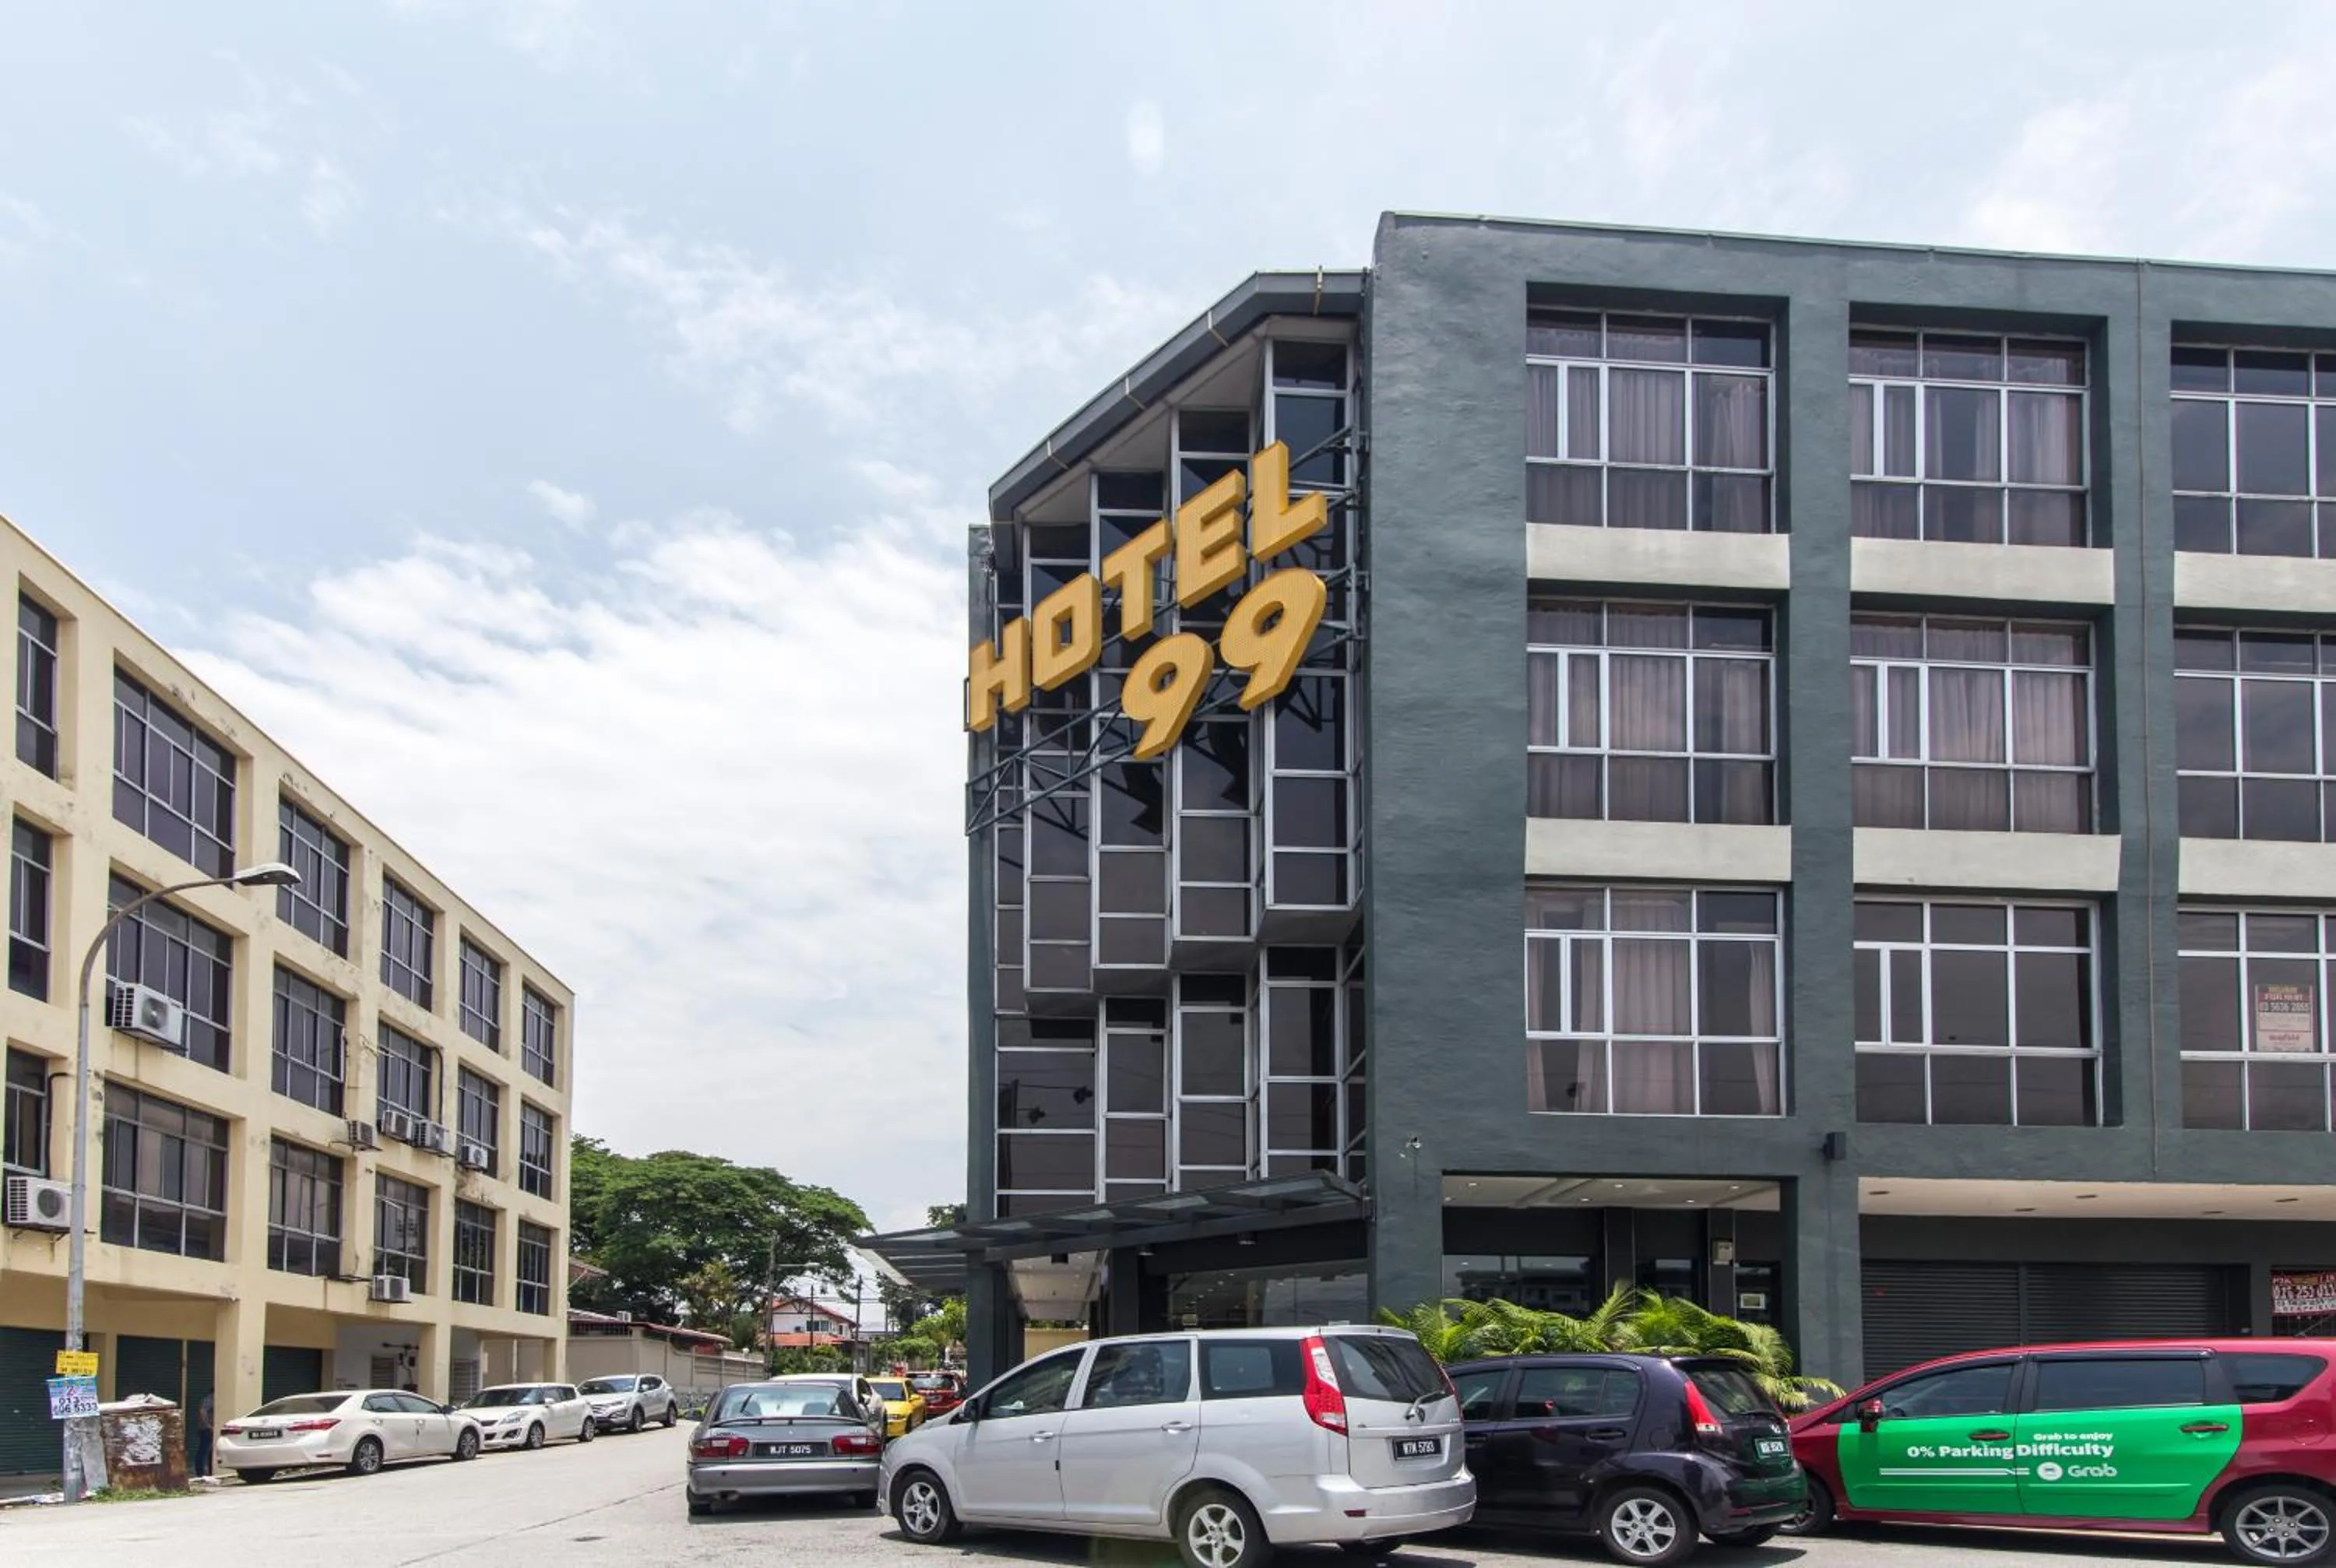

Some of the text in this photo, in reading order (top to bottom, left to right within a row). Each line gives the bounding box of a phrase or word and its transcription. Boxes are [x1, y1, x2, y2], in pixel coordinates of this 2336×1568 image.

[969, 439, 1328, 733] HOTEL
[1121, 567, 1327, 761] 99
[2033, 1433, 2062, 1441] Grab
[2079, 1432, 2113, 1441] enjoy
[1907, 1443, 2114, 1460] 0% Parking Difficulty
[2067, 1463, 2117, 1478] Grab
